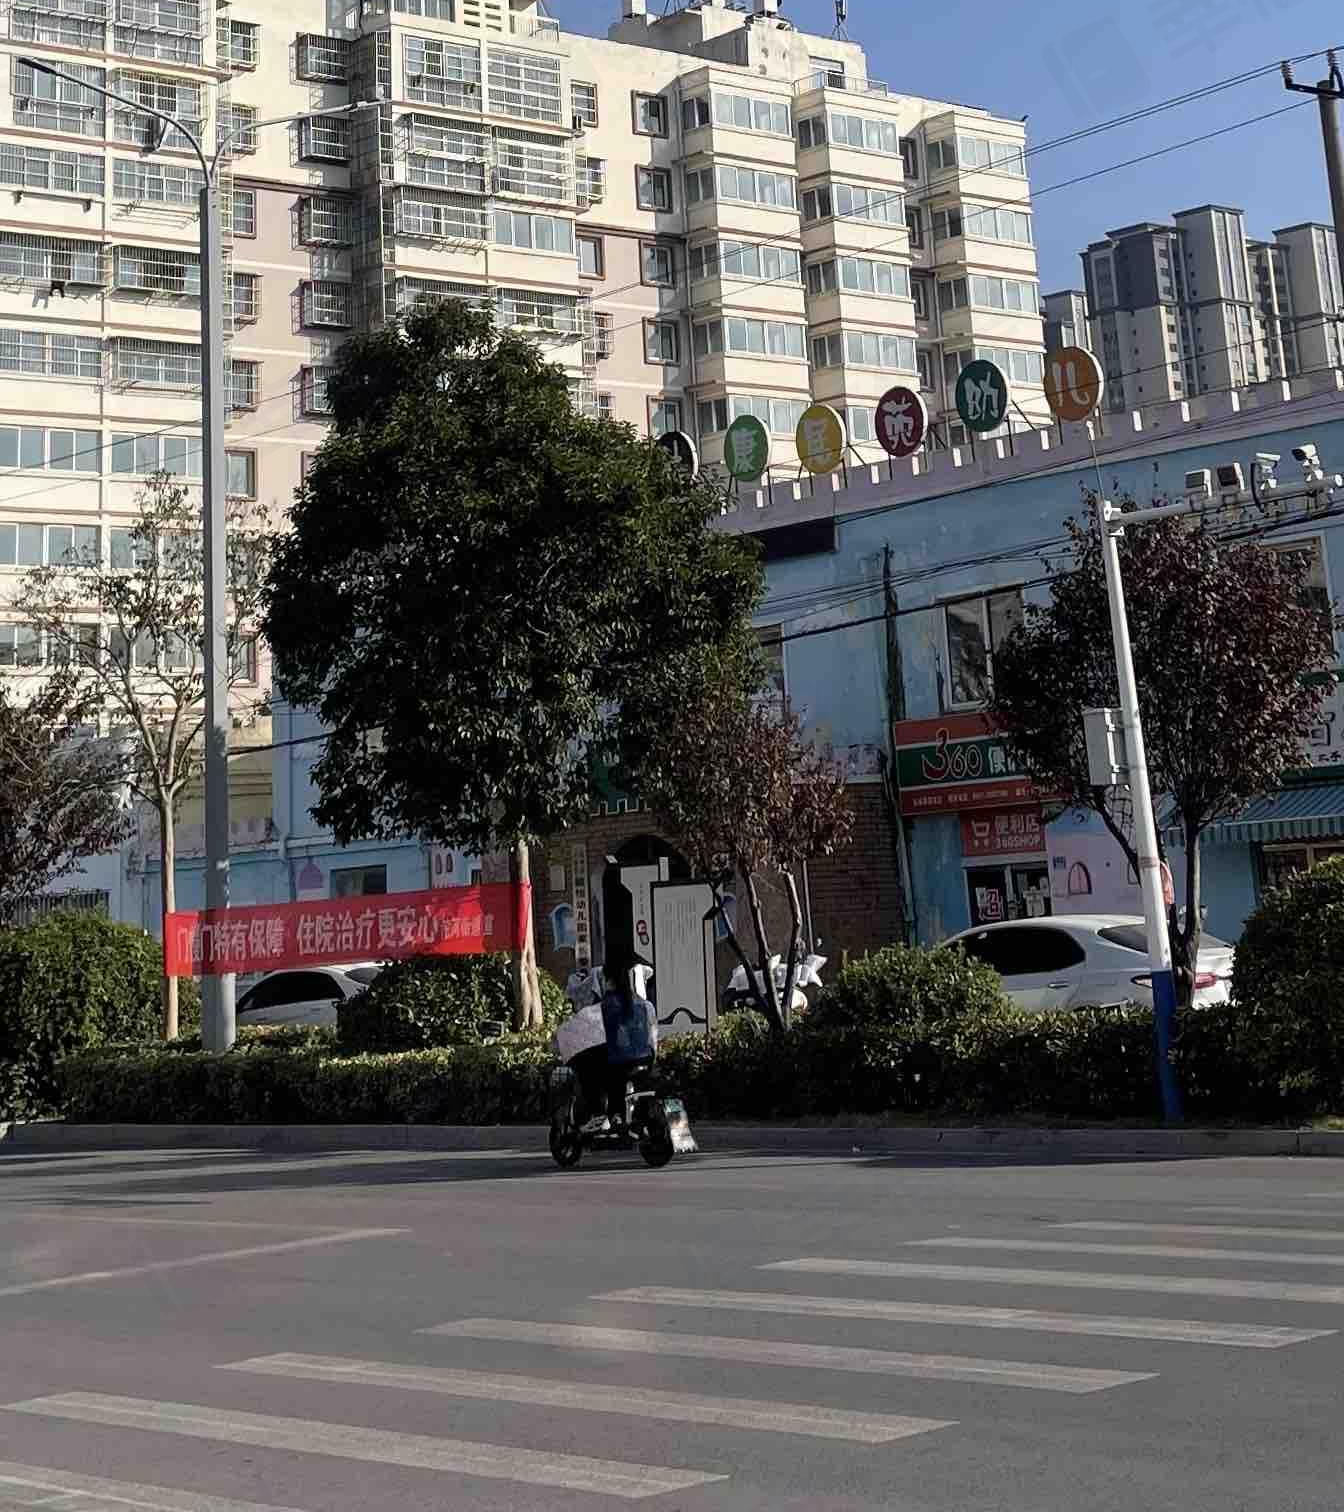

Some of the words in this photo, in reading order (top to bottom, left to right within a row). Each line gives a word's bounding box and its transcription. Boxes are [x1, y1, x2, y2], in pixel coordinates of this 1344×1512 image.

[296, 904, 439, 955] 住院治疗更安心
